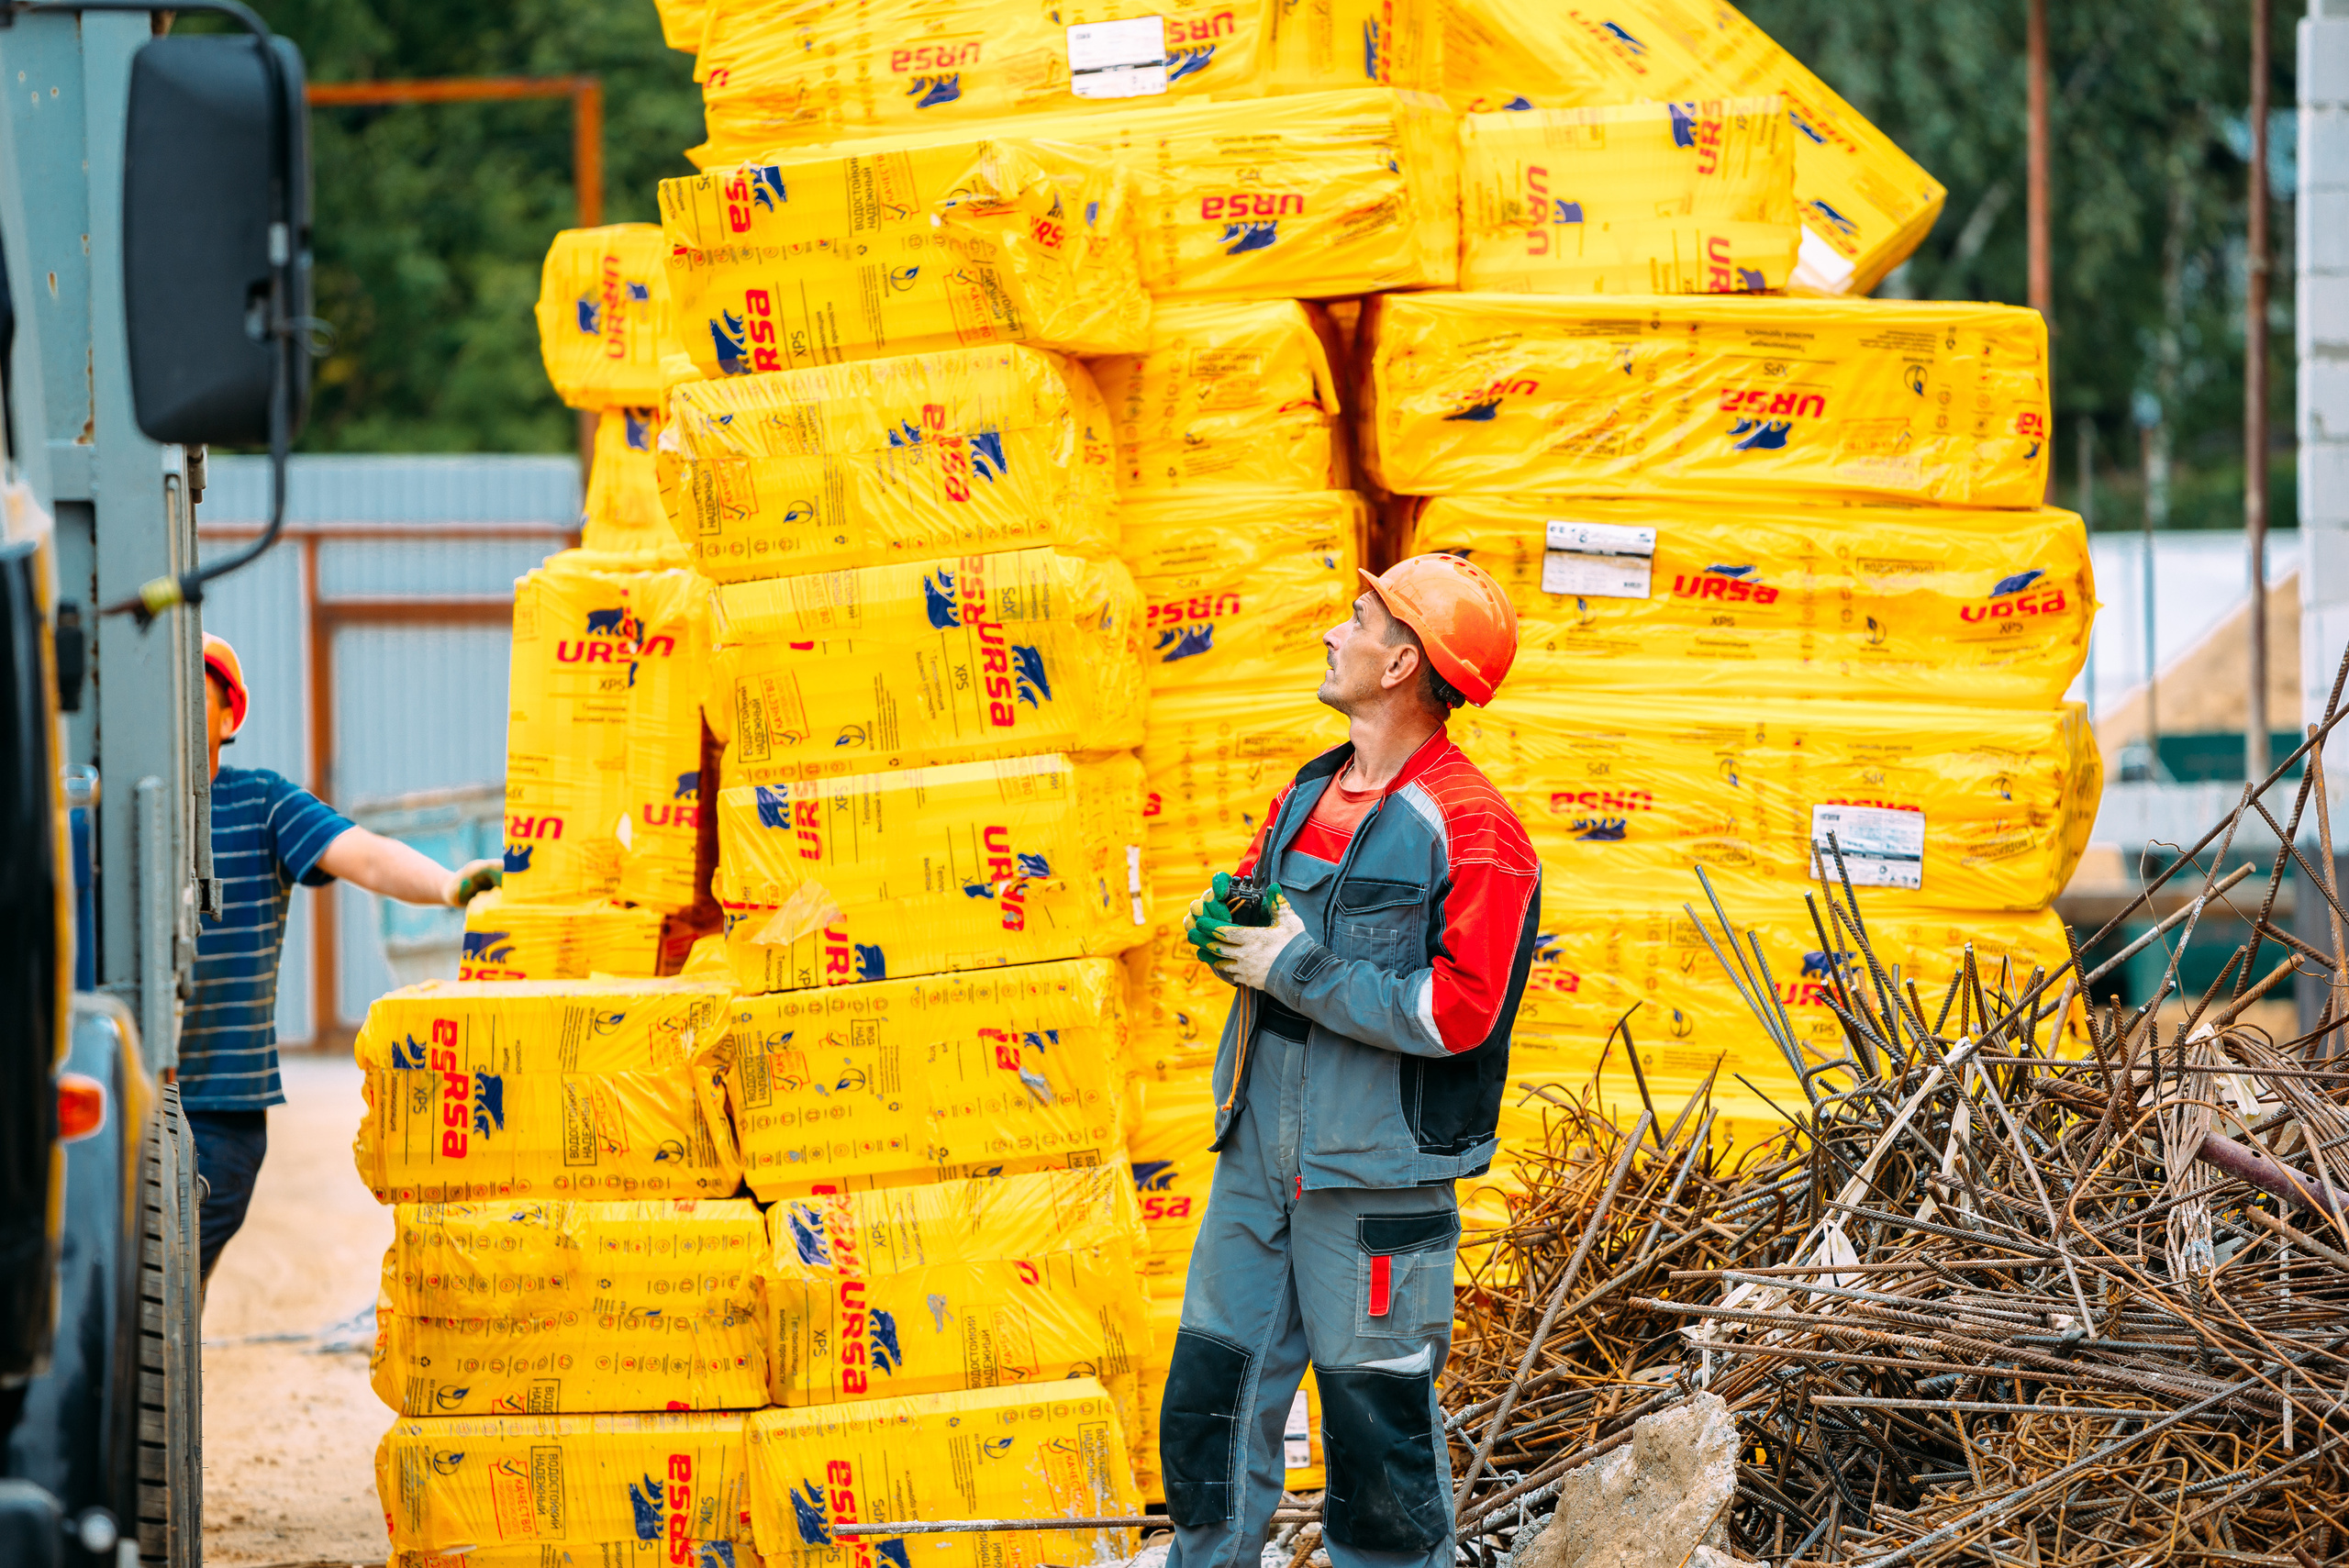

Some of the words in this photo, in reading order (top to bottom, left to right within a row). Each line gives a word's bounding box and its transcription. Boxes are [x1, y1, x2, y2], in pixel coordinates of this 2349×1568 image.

[1168, 12, 1235, 44] URS
[876, 154, 896, 203] КАЧЕСТВ
[1201, 194, 1304, 220] URSA
[745, 289, 782, 371] RSA
[791, 330, 807, 358] XPS
[1763, 361, 1789, 377] XPS
[1719, 388, 1826, 418] URSA
[960, 555, 986, 625] RSA
[1002, 587, 1017, 614] XPS
[1673, 575, 1779, 605] URSA
[1709, 616, 1736, 628] XPS
[916, 651, 929, 682] высокой
[924, 683, 937, 720] прочности
[929, 654, 945, 711] Теплоизоляция
[954, 663, 970, 691] XPS
[977, 623, 1016, 728] URSA
[737, 685, 753, 757] ВОДОСТОЙКИЙ
[750, 697, 765, 755] НАДЕЖНЫЙ
[763, 677, 784, 729] КАЧЕСТВО
[1586, 762, 1610, 776] XPS
[1862, 772, 1885, 785] XPS
[795, 780, 823, 861] URS
[834, 785, 849, 812] XPS
[874, 799, 883, 833] высокой
[1550, 790, 1653, 814] URSA
[764, 948, 773, 982] высокой
[798, 967, 811, 985] XP
[413, 1086, 428, 1115] XPS
[441, 1072, 469, 1159] RSA
[564, 1081, 580, 1159] ВОДОСТОЙКИЙ
[578, 1095, 593, 1159] НАДЕЖНЫЙ
[872, 1220, 886, 1249] XPS
[791, 1315, 801, 1377] Теплоизоляция
[813, 1329, 827, 1358] XPS
[841, 1282, 868, 1395] URSA
[966, 1315, 982, 1389] ВОДОСТОЙКИЙ
[981, 1329, 994, 1388] НАДЕЖНЫЙ
[994, 1310, 1012, 1365] КАЧЕСТВО
[515, 1478, 533, 1534] КАЧЕСТВО
[535, 1453, 551, 1516] НАДЕЖНЫЙ
[548, 1453, 562, 1530] ВОДОСТОЙКИЙ
[668, 1454, 692, 1540] RSA
[905, 1470, 918, 1508] прочности
[1065, 1454, 1085, 1508] КАЧЕСТВО
[699, 1496, 715, 1525] XPS
